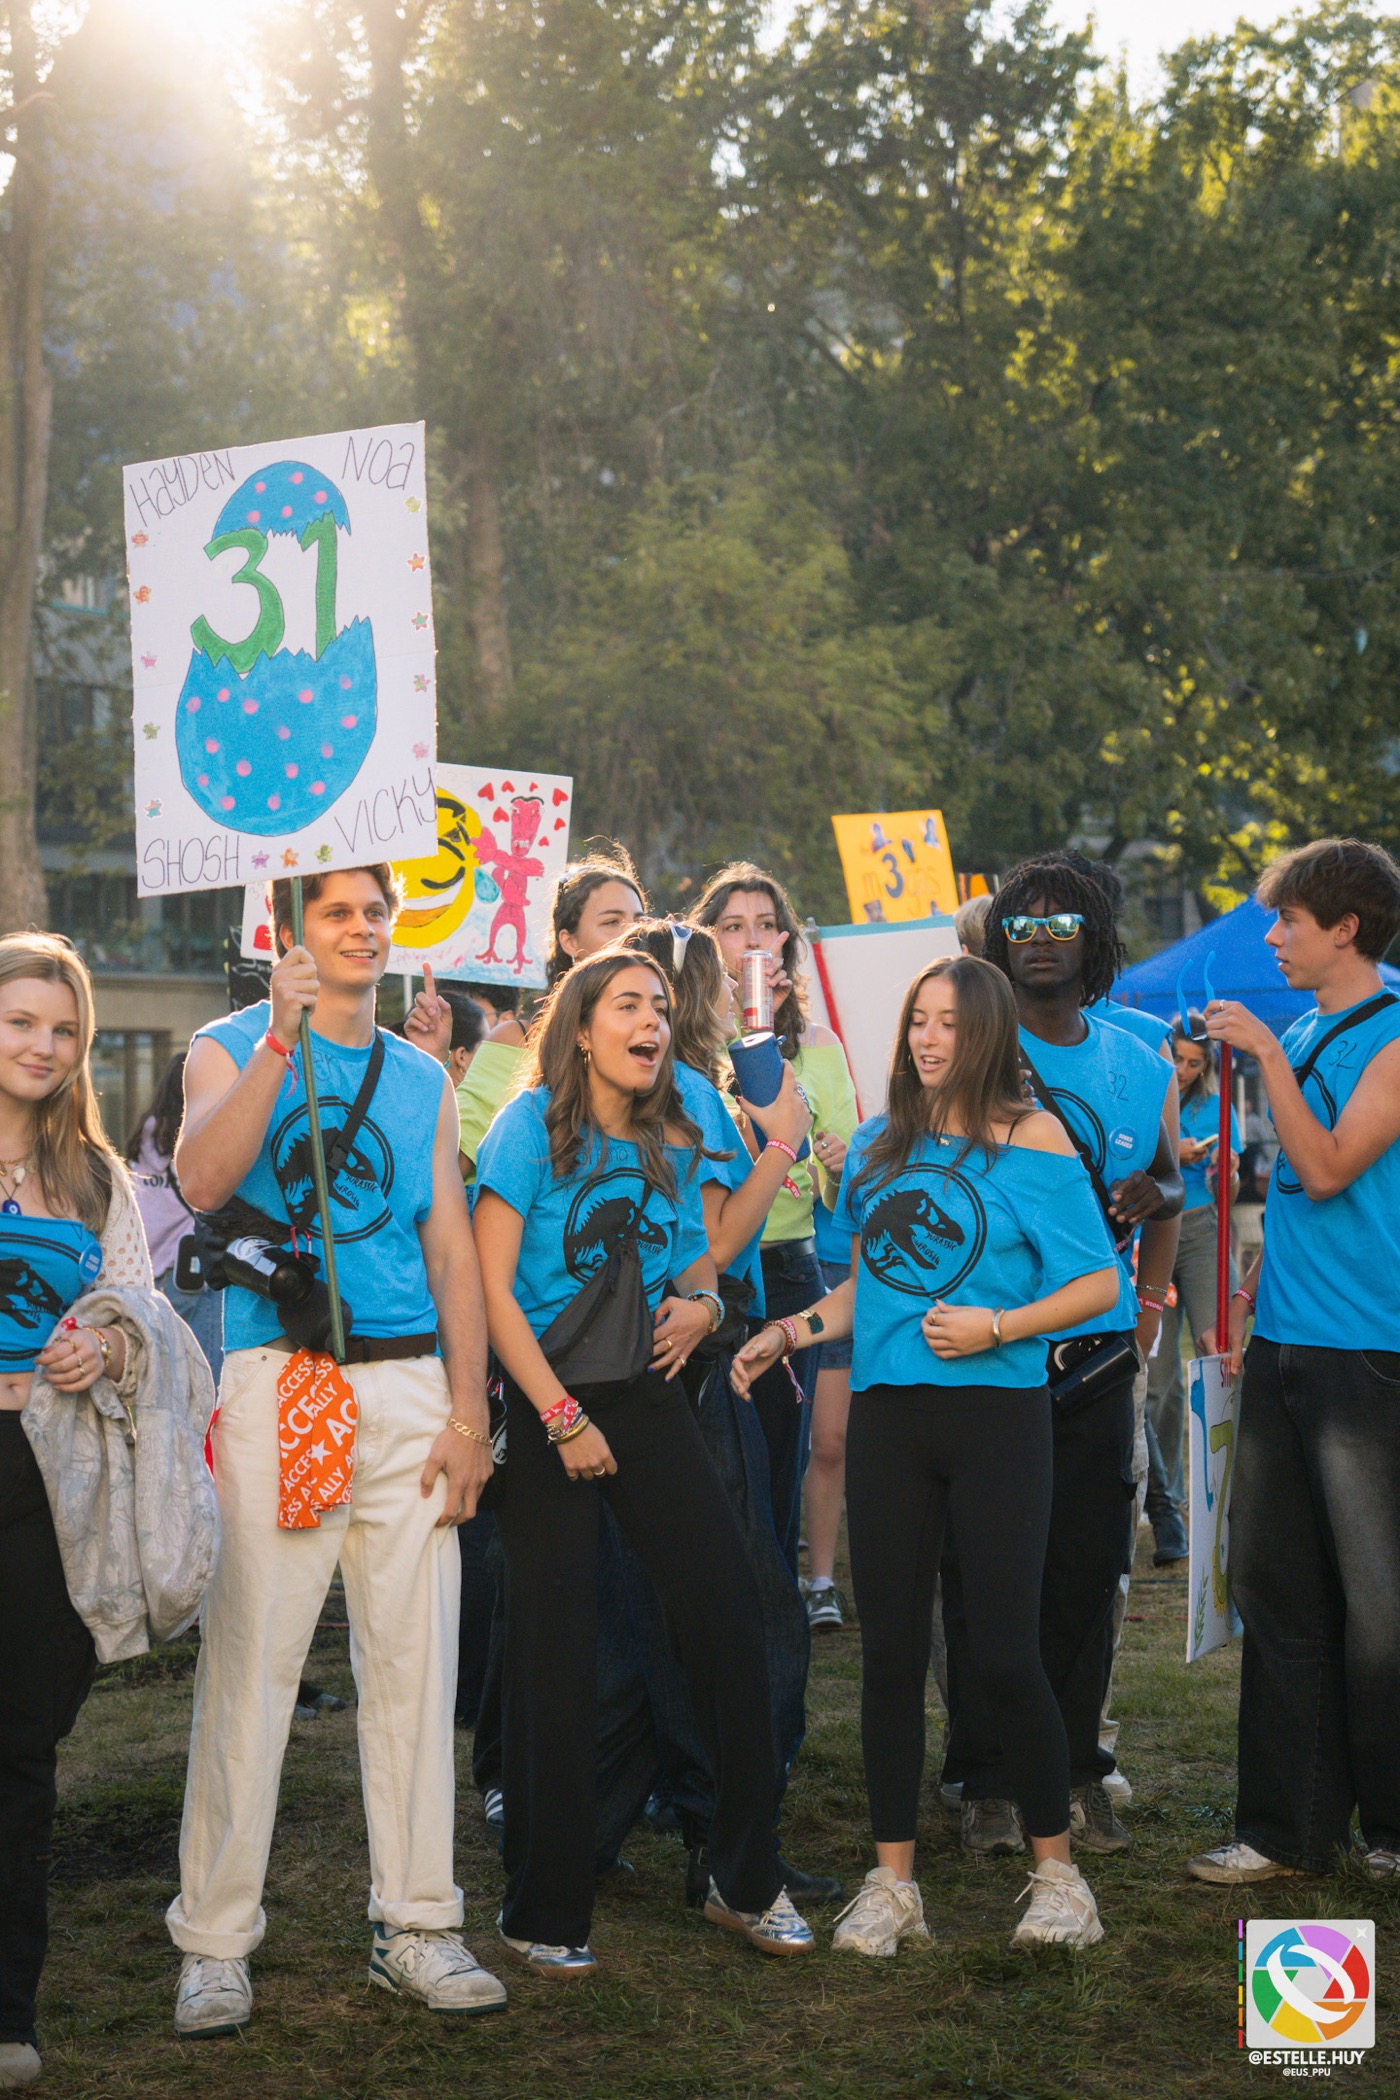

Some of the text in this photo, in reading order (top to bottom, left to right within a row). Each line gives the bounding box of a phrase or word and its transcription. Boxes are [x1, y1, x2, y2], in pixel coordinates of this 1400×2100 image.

[190, 510, 338, 674] 31
[142, 834, 240, 889] SHOSH
[1107, 1071, 1130, 1102] 32
[345, 1174, 379, 1193] JURASSIC
[925, 1232, 957, 1251] JURASSIC
[312, 1381, 338, 1418] ALLY
[318, 1466, 345, 1502] ALLY
